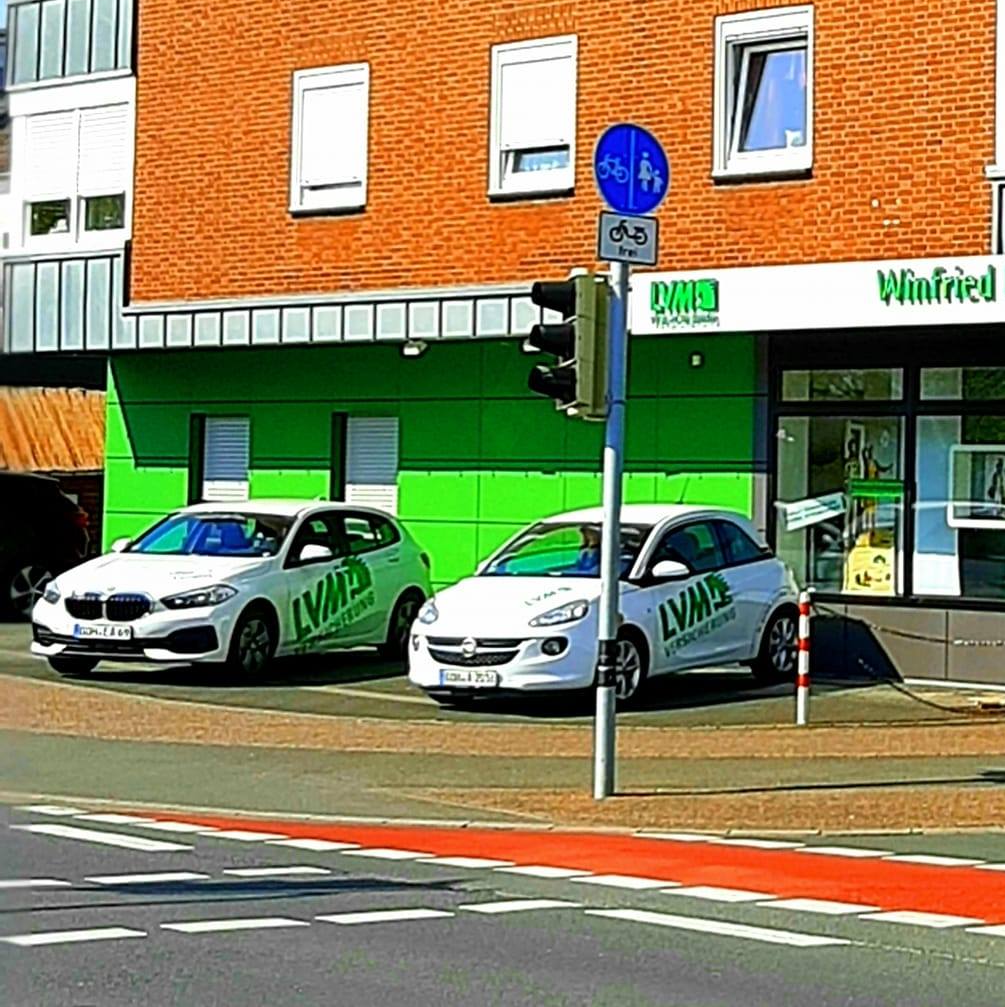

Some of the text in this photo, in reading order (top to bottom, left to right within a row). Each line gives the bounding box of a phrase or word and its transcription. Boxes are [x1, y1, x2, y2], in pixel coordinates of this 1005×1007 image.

[618, 245, 637, 257] frei
[651, 280, 698, 314] LVM
[877, 264, 996, 306] Winfried
[293, 571, 349, 641] LVM
[659, 581, 713, 642] LVM
